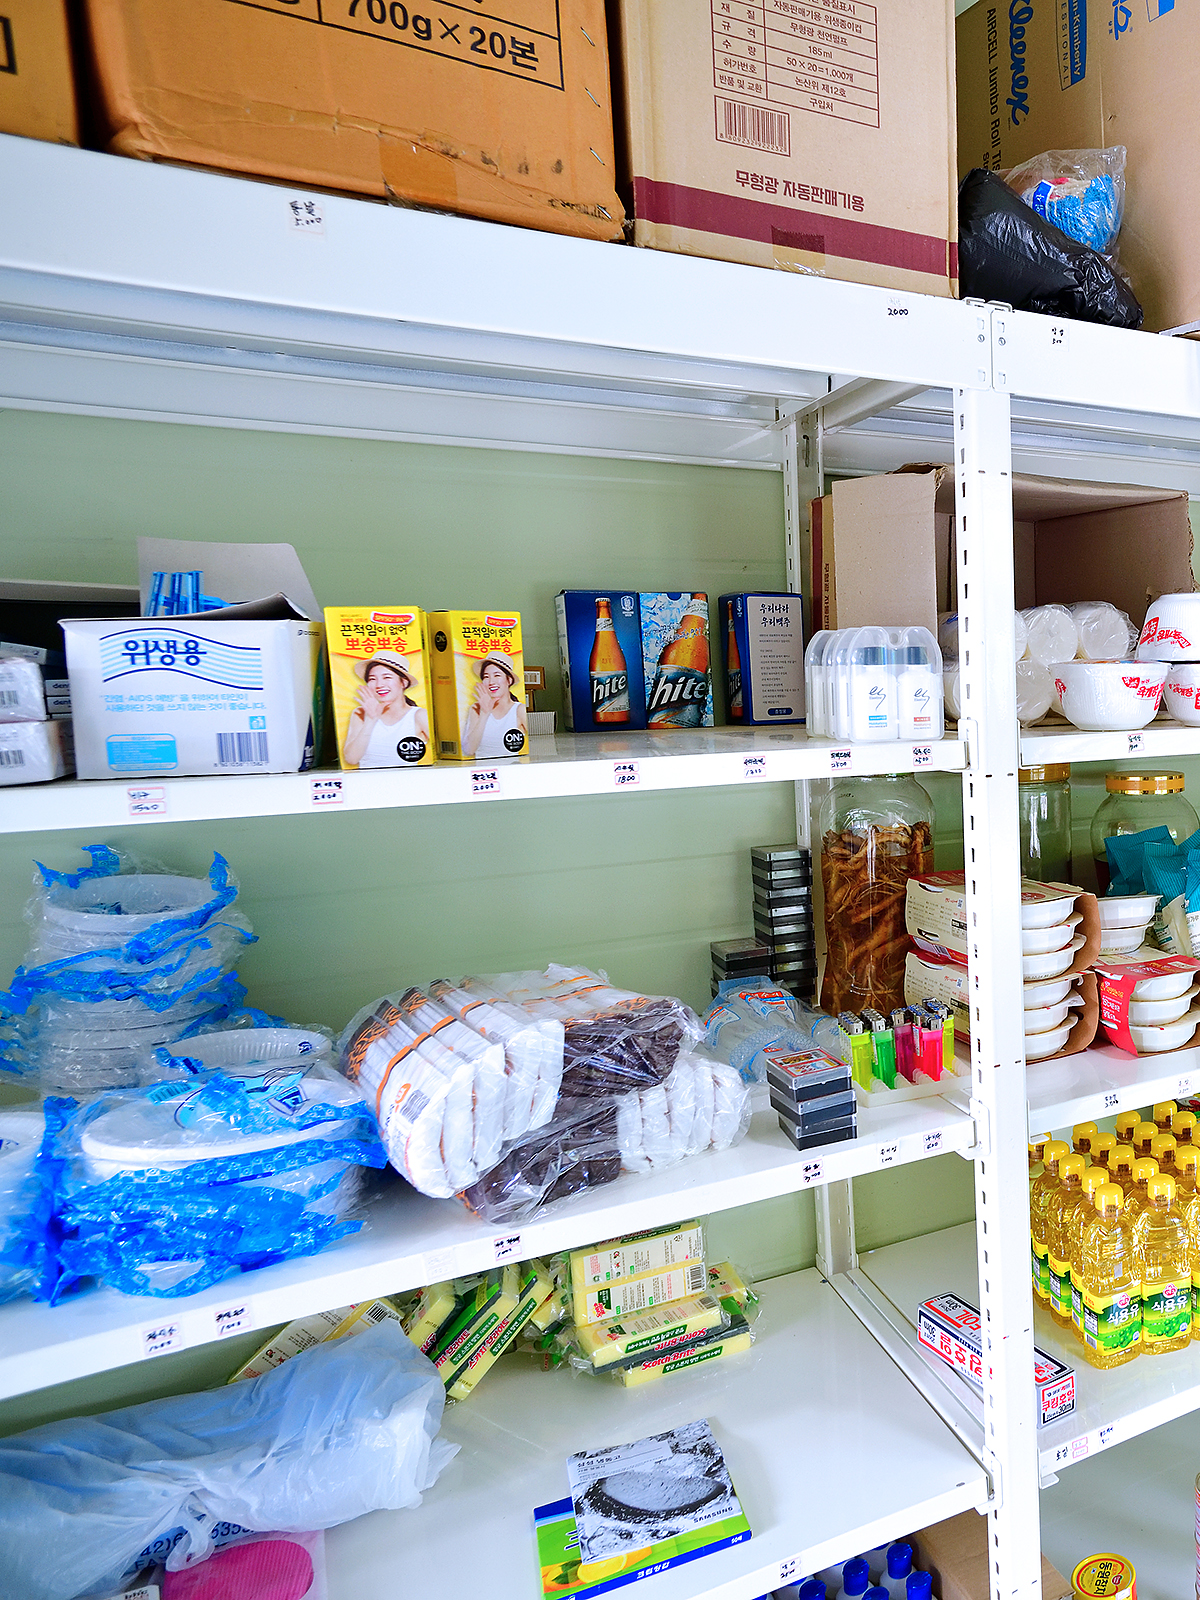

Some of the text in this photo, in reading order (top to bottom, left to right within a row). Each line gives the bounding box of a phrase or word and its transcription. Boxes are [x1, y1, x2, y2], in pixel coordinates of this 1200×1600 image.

[824, 14, 862, 34] 위생종이컵
[790, 22, 848, 46] 무형광 천연펄프
[986, 8, 999, 64] AIRCELL
[723, 57, 757, 74] 허가번호
[786, 57, 797, 67] 50
[719, 74, 762, 94] 반품 및 교환
[810, 98, 833, 111] 구입처
[991, 118, 1001, 149] Roll
[736, 170, 864, 212] 무형광 자동판매기용
[887, 307, 909, 318] 2000
[759, 602, 790, 614] 우리나라
[340, 625, 407, 636] 끈적임이 없어
[761, 616, 791, 628] 우리맥주
[462, 626, 496, 638] 끈적임이
[122, 639, 207, 666] 위생용
[346, 637, 407, 653] 뽀송뽀송
[466, 638, 513, 653] 뽀송뽀송
[593, 673, 627, 703] hite
[651, 676, 707, 710] hite
[617, 774, 635, 783] 1800
[1106, 1303, 1139, 1325] 식용유
[1151, 1296, 1187, 1314] 식용유
[693, 1506, 734, 1524] SAMSUNG
